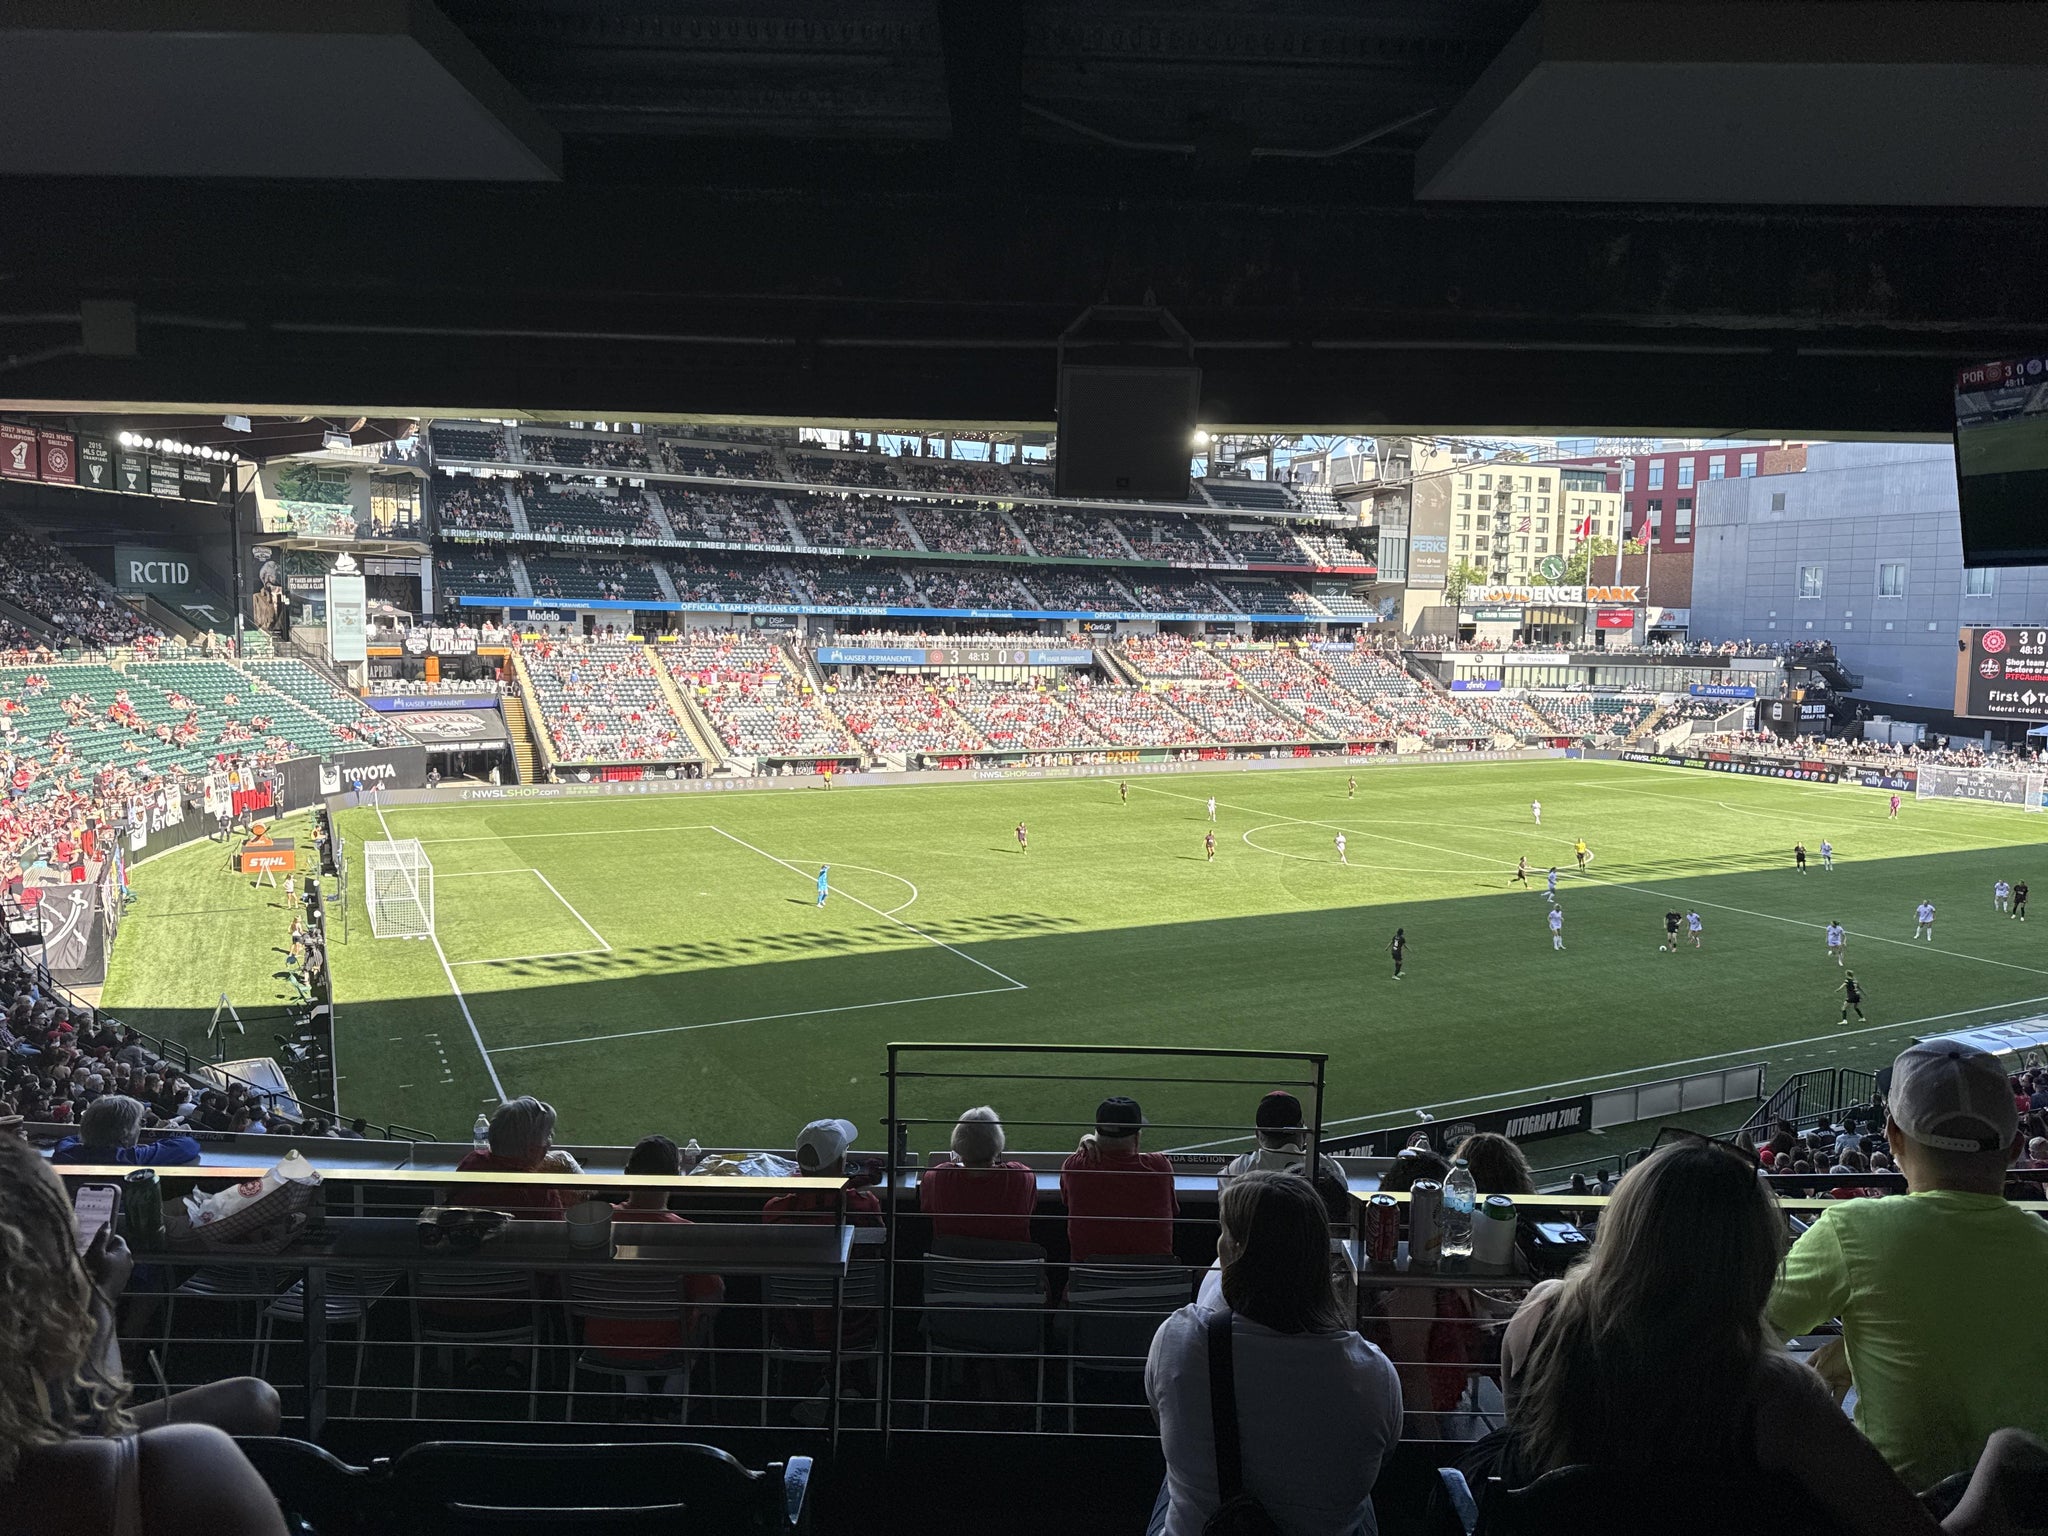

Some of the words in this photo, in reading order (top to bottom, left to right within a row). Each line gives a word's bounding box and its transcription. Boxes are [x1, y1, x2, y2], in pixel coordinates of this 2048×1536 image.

[1962, 370, 1984, 384] POR
[2005, 365, 2012, 377] 3
[2016, 363, 2024, 375] 0
[1, 432, 35, 442] CHAMPIONS
[16, 428, 35, 436] NWSL
[83, 448, 95, 456] MLS
[96, 449, 107, 457] CUP
[150, 469, 179, 479] CHAMPIONS
[184, 474, 211, 483] CHAMPIONS
[151, 487, 180, 496] CHAMPIONS
[451, 529, 470, 538] RING
[477, 530, 504, 539] HONOR
[510, 532, 533, 541] JOHN
[535, 533, 556, 542] BAIN
[560, 534, 586, 544] CLIVE
[587, 535, 625, 545] CHARLES
[630, 537, 657, 546] JIMMY
[658, 539, 691, 548] CONWAY
[696, 541, 726, 550] TIMBER
[727, 542, 741, 550] JIM
[745, 543, 765, 551] MICK
[766, 544, 791, 553] HOBAN
[795, 546, 818, 554] DIEGO
[818, 547, 845, 555] VALERI
[1412, 540, 1448, 553] PERKS
[130, 560, 189, 584] RCTID
[1468, 585, 1582, 602] PROVIDENCE
[1586, 585, 1640, 602] PARK
[681, 602, 718, 611] OFFICIAL
[719, 603, 741, 611] TEAM
[743, 604, 787, 612] PHYSICIANS
[817, 606, 857, 614] PORTLAND
[859, 607, 888, 615] THORNS
[527, 609, 560, 621] Modelo
[2019, 631, 2029, 645] 3
[2036, 631, 2046, 645] 0
[2019, 645, 2043, 655] 48:13
[844, 654, 866, 662] KAISER
[950, 650, 959, 664] 3
[968, 652, 990, 661] 48:13
[998, 650, 1007, 664] 0
[2005, 658, 2025, 667] Shop
[2026, 659, 2045, 667] team
[1466, 682, 1486, 690] xfinity
[1706, 686, 1735, 695] axiom
[1989, 690, 2019, 702] First
[1988, 704, 2016, 713] federal
[2017, 705, 2042, 714] credit
[1106, 750, 1140, 764] PARK
[1630, 753, 1681, 766] NWSLSHOP.com
[342, 763, 396, 783] TOYOTA
[979, 770, 1041, 779] NWSLSHOP.com
[1857, 769, 1880, 777] TOYOTA
[1865, 776, 1884, 787] ally
[1890, 778, 1910, 790] ally
[472, 788, 560, 799] NWSLSHOP.com
[1967, 787, 2013, 801] DELTA
[249, 856, 287, 867] STIHL
[1505, 1111, 1558, 1138] AUTOGRAPH
[1557, 1106, 1582, 1129] ZONE
[1187, 1155, 1226, 1163] SECTION
